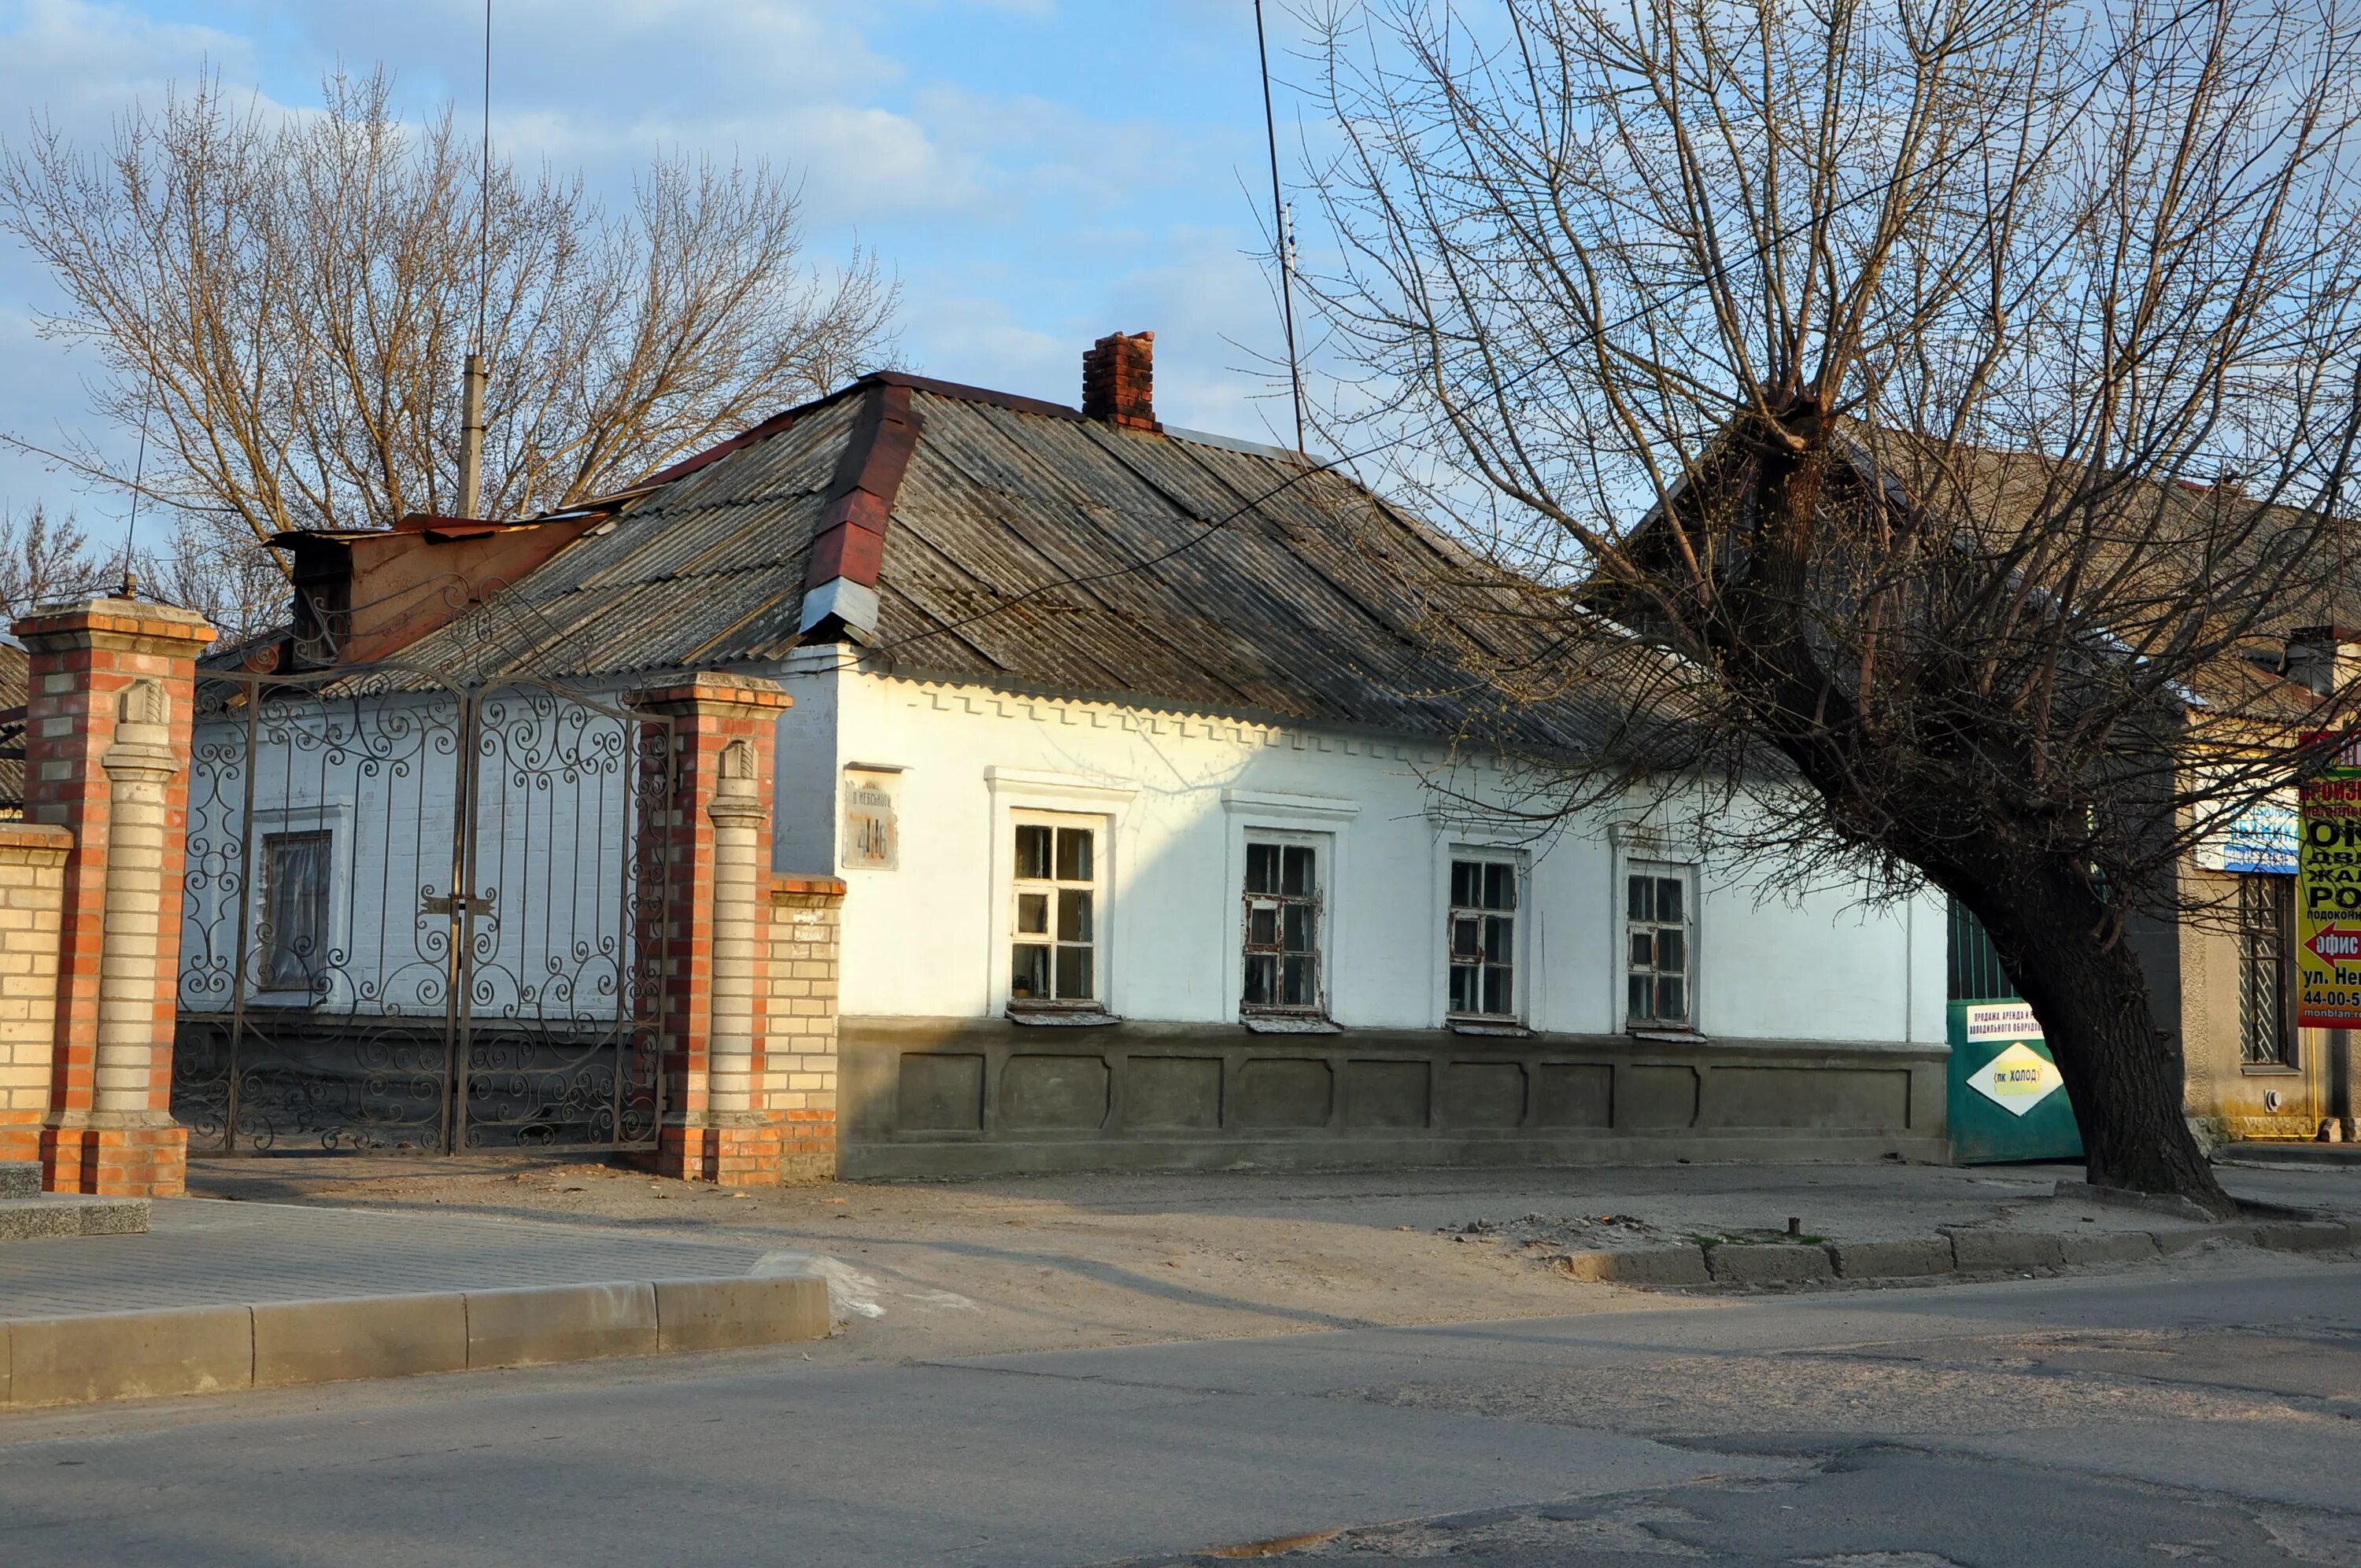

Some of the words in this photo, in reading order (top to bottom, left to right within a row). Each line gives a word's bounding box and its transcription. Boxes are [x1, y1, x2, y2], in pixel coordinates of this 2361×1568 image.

[2307, 852, 2361, 865] ДВ
[2308, 869, 2361, 882] ЖА
[2304, 971, 2329, 988] ул.
[2335, 967, 2361, 985] Не
[2002, 1011, 2023, 1020] АРЕНДА
[1969, 1024, 2012, 1035] ХОЛОДИЛЬНОГО
